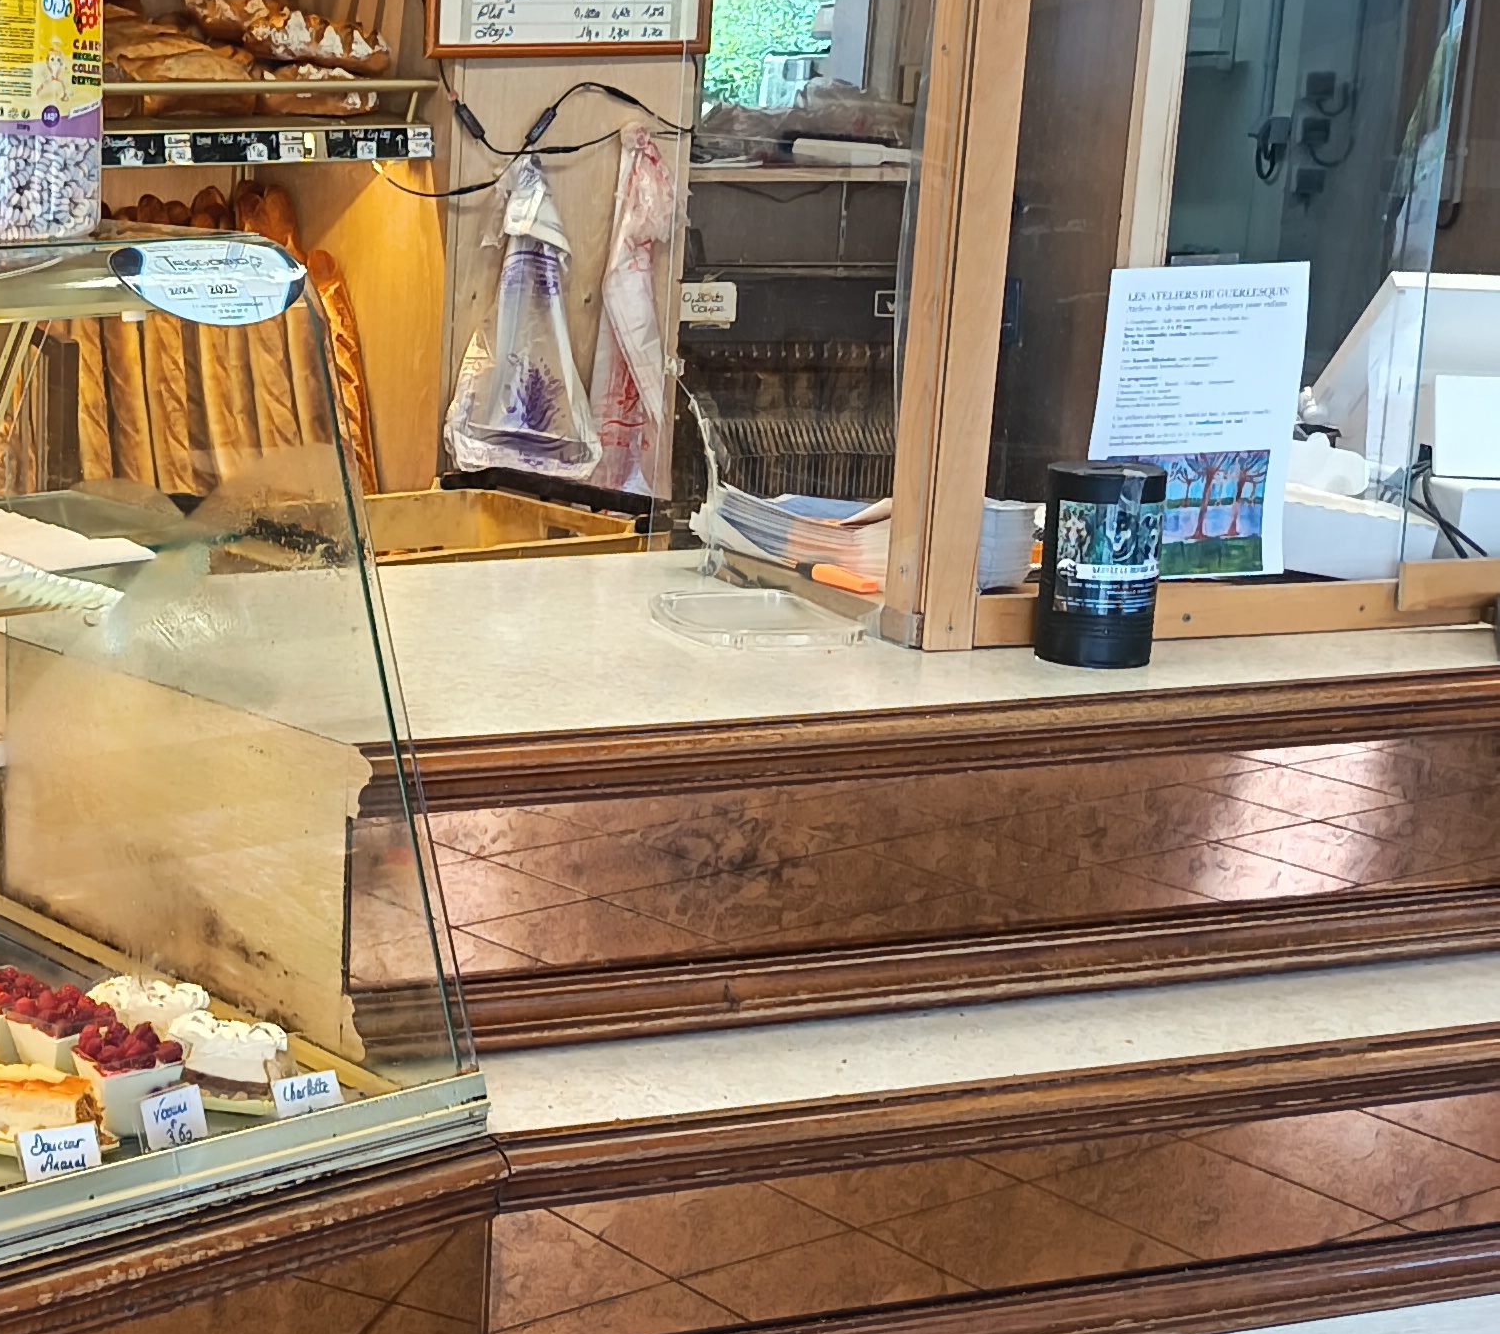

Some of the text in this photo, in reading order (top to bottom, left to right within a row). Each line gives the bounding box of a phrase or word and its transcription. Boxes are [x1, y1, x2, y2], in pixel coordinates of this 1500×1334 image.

[207, 284, 238, 295] 2025
[1128, 292, 1146, 301] LES
[1149, 290, 1198, 301] ATELIERS
[1200, 289, 1214, 299] DE
